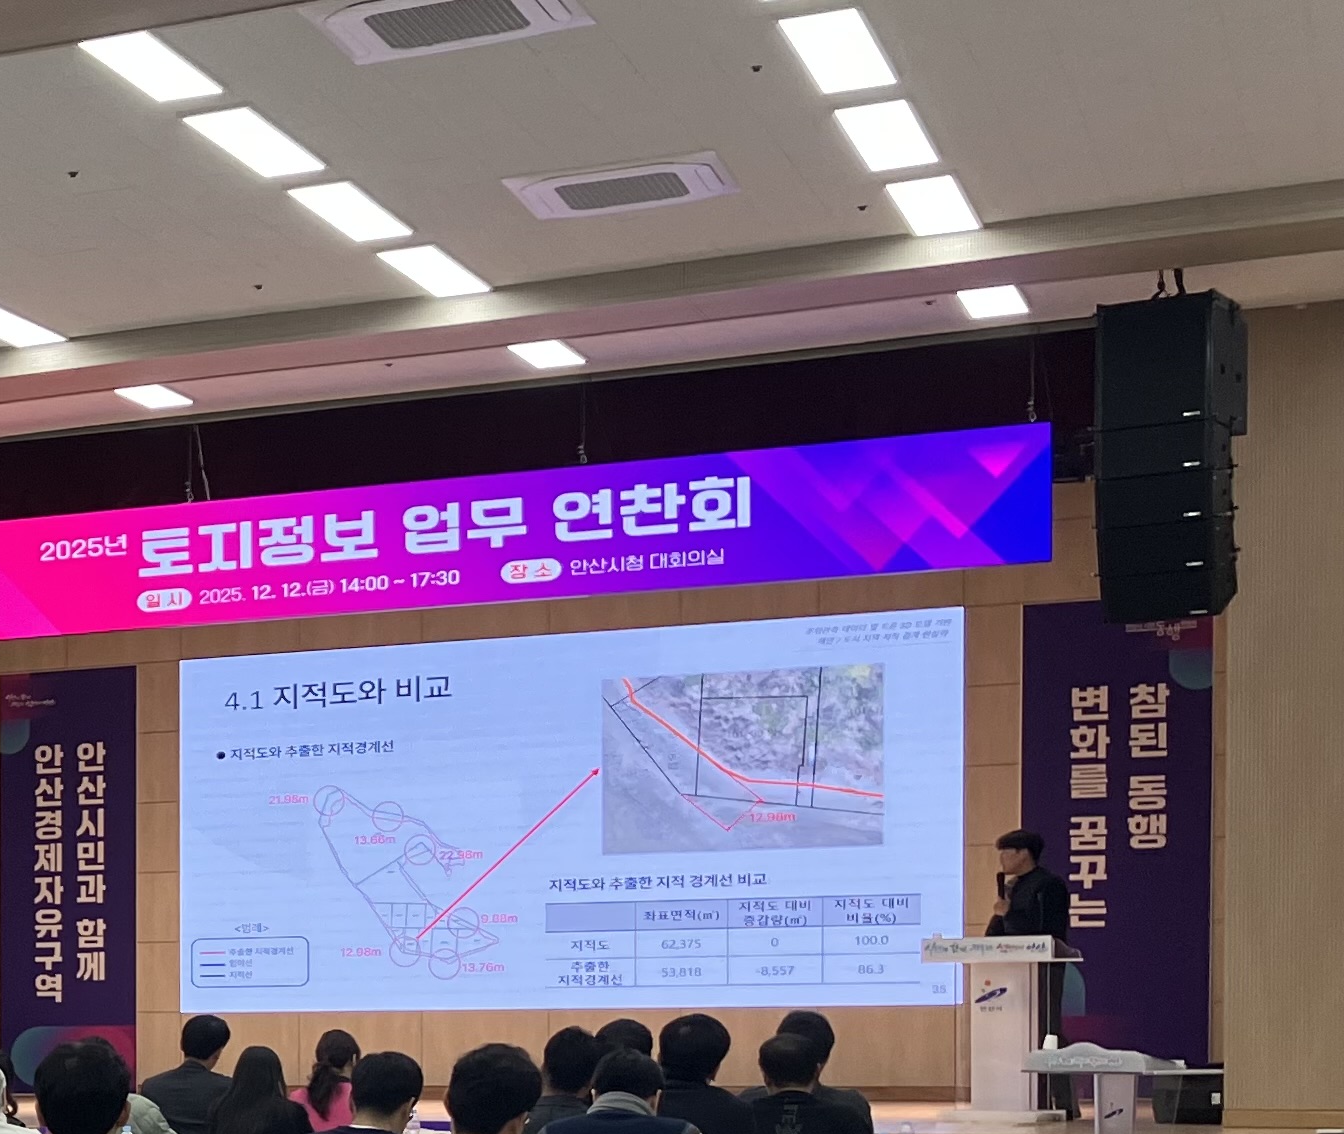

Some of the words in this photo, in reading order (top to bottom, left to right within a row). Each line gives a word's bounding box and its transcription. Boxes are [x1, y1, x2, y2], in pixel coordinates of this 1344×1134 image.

[39, 533, 128, 562] 2025년
[138, 510, 379, 578] 토지정보
[402, 497, 527, 554] 업무
[552, 476, 751, 542] 연찬회
[570, 555, 644, 577] 안산시청
[650, 548, 725, 571] 대회의실
[199, 587, 247, 605] 2025.
[252, 585, 277, 601] 12.
[339, 575, 389, 594] 14:00
[411, 570, 460, 588] 17:30
[224, 690, 264, 711] 4.1
[273, 677, 387, 710] 지적도와
[395, 675, 452, 702] 비교
[1129, 682, 1170, 758] 참된
[230, 746, 282, 760] 지적도와
[285, 743, 324, 758] 추출한
[328, 740, 394, 756] 지적경계선
[1070, 685, 1110, 799] 변화를
[76, 741, 106, 904] 안산시민과
[1128, 774, 1167, 849] 동행
[34, 744, 63, 1003] 안산경제자유구역
[549, 878, 606, 892] 지적도와
[609, 876, 652, 890] 추출한
[656, 875, 685, 889] 지적
[689, 873, 733, 888] 경계선
[737, 873, 767, 887] 비교
[1069, 815, 1107, 928] 꿈꾸는
[739, 900, 779, 912] 지적도
[785, 899, 812, 911] 대비
[834, 898, 875, 910] 지적도
[881, 897, 910, 909] 대비
[847, 912, 897, 924] 비율(%)
[76, 919, 106, 981] 함께
[571, 939, 610, 951] 지적도
[661, 939, 702, 951] 62,375
[855, 935, 889, 946] 100.0
[558, 974, 623, 986] 지적경계선
[571, 960, 610, 972] 추출한
